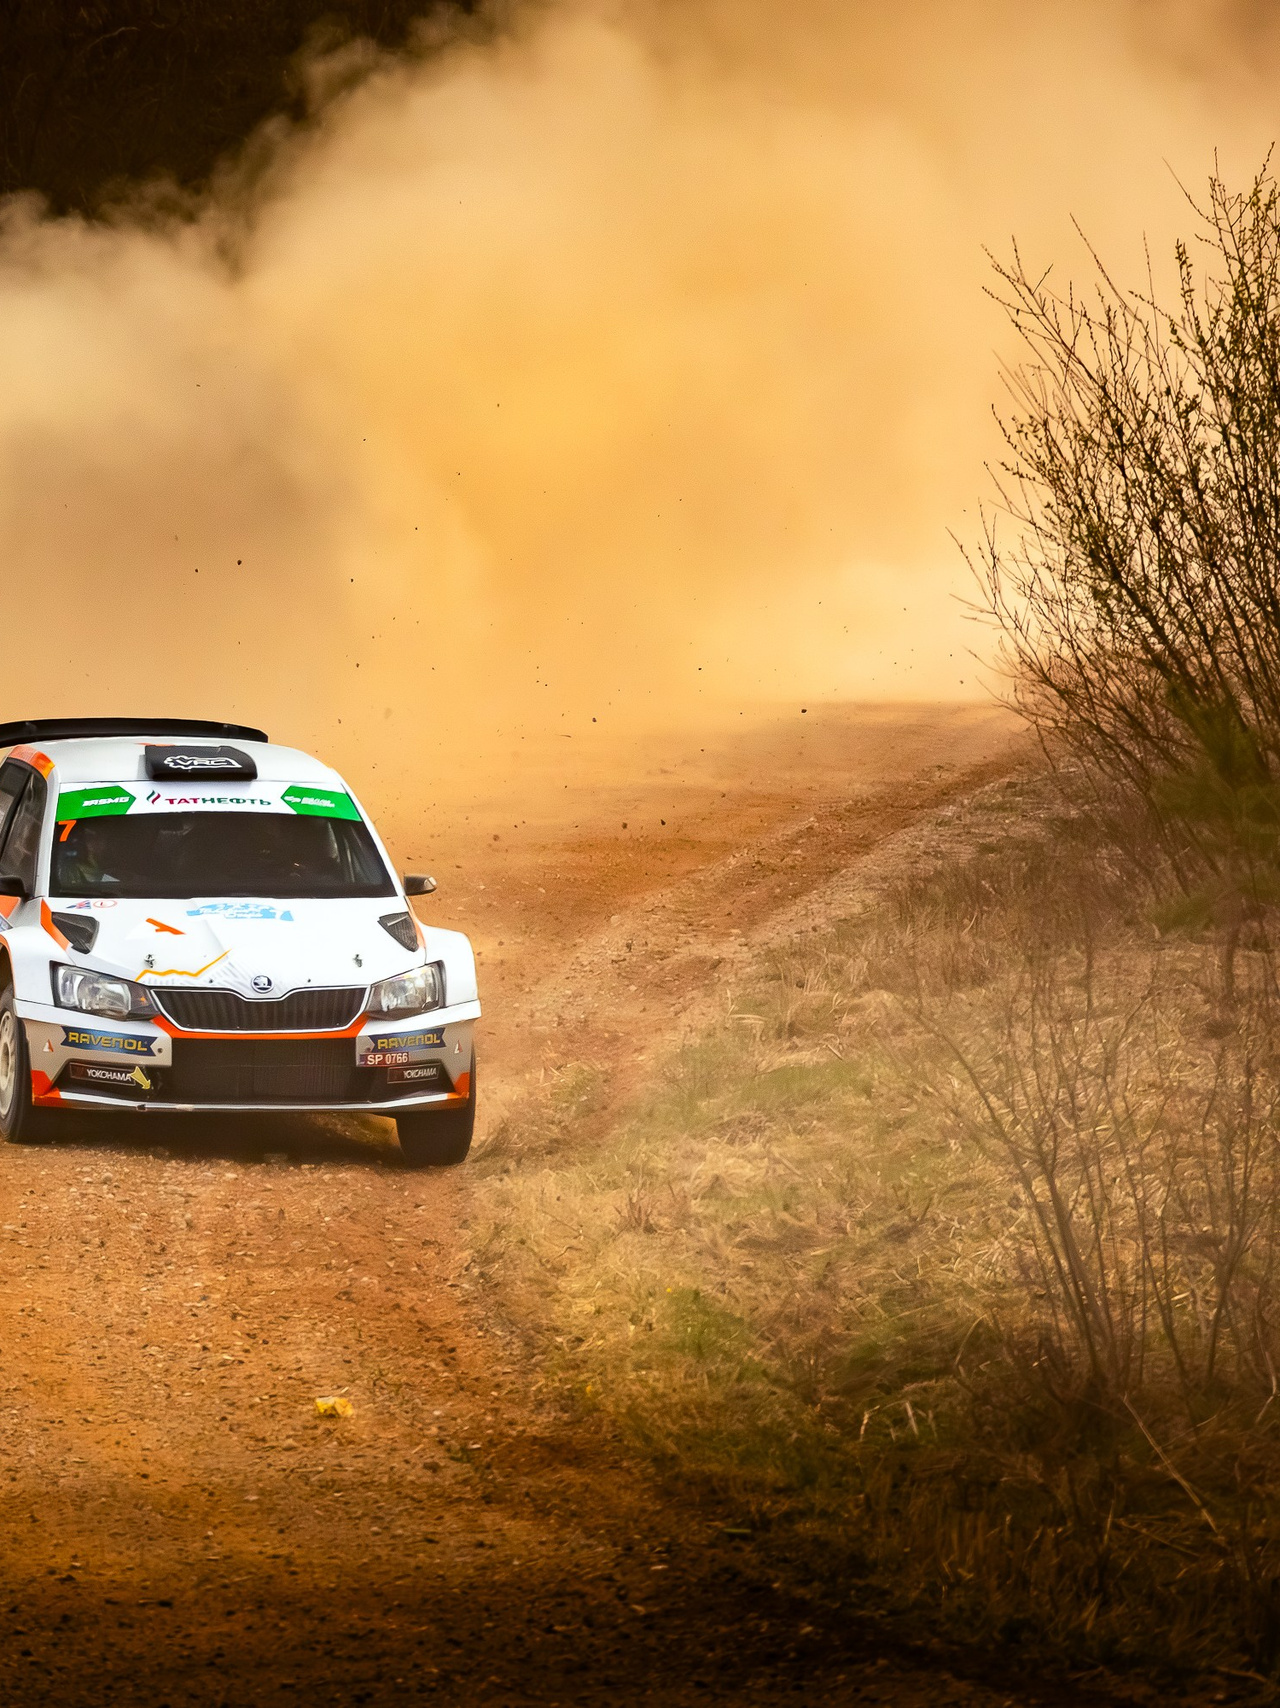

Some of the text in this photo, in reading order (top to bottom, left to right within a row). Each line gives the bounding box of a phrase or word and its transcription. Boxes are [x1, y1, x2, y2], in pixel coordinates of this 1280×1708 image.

[164, 797, 272, 806] ТАТНЕФТЬ
[58, 819, 77, 842] 7
[68, 1032, 148, 1052] RAVENOL
[377, 1033, 441, 1050] RAVENOL
[366, 1052, 409, 1066] SP 0766
[86, 1068, 132, 1082] YOKOHAMA
[403, 1067, 437, 1079] YOKOHAMA
